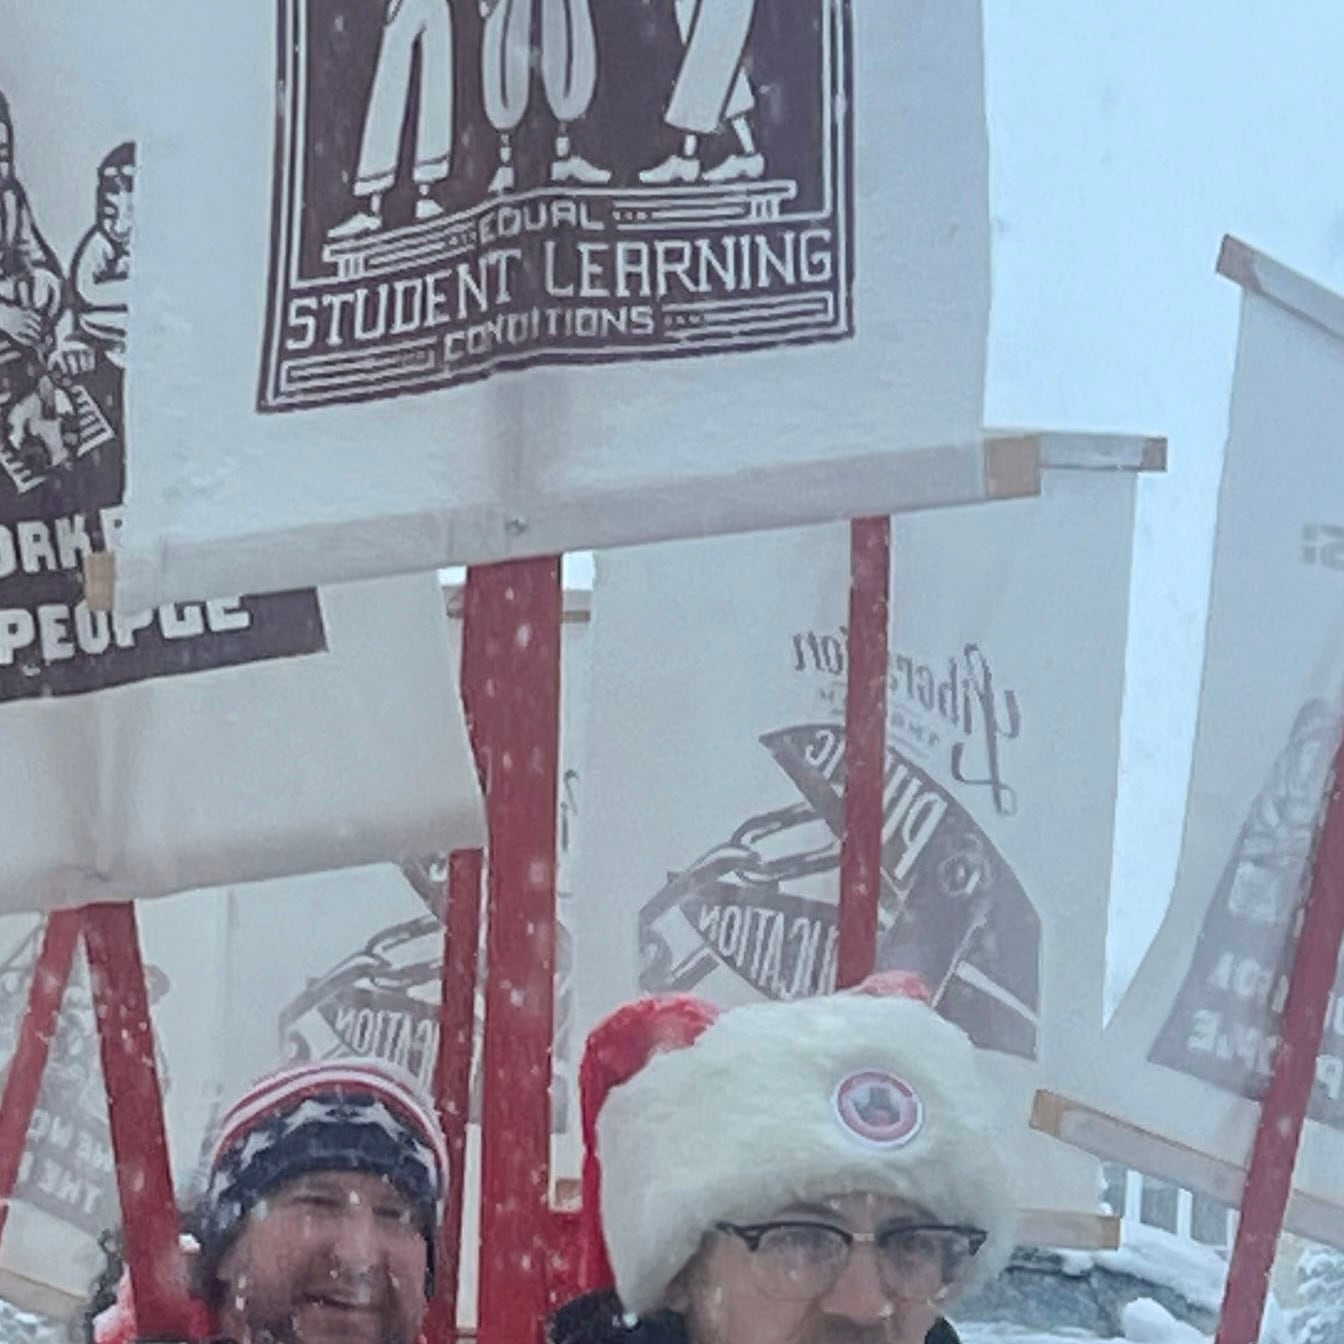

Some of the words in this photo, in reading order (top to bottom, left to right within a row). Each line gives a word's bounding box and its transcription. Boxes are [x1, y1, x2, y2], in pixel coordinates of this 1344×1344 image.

[285, 248, 523, 352] STUDENT
[542, 228, 834, 299] LEARNING
[441, 304, 657, 363] CONDITIONS
